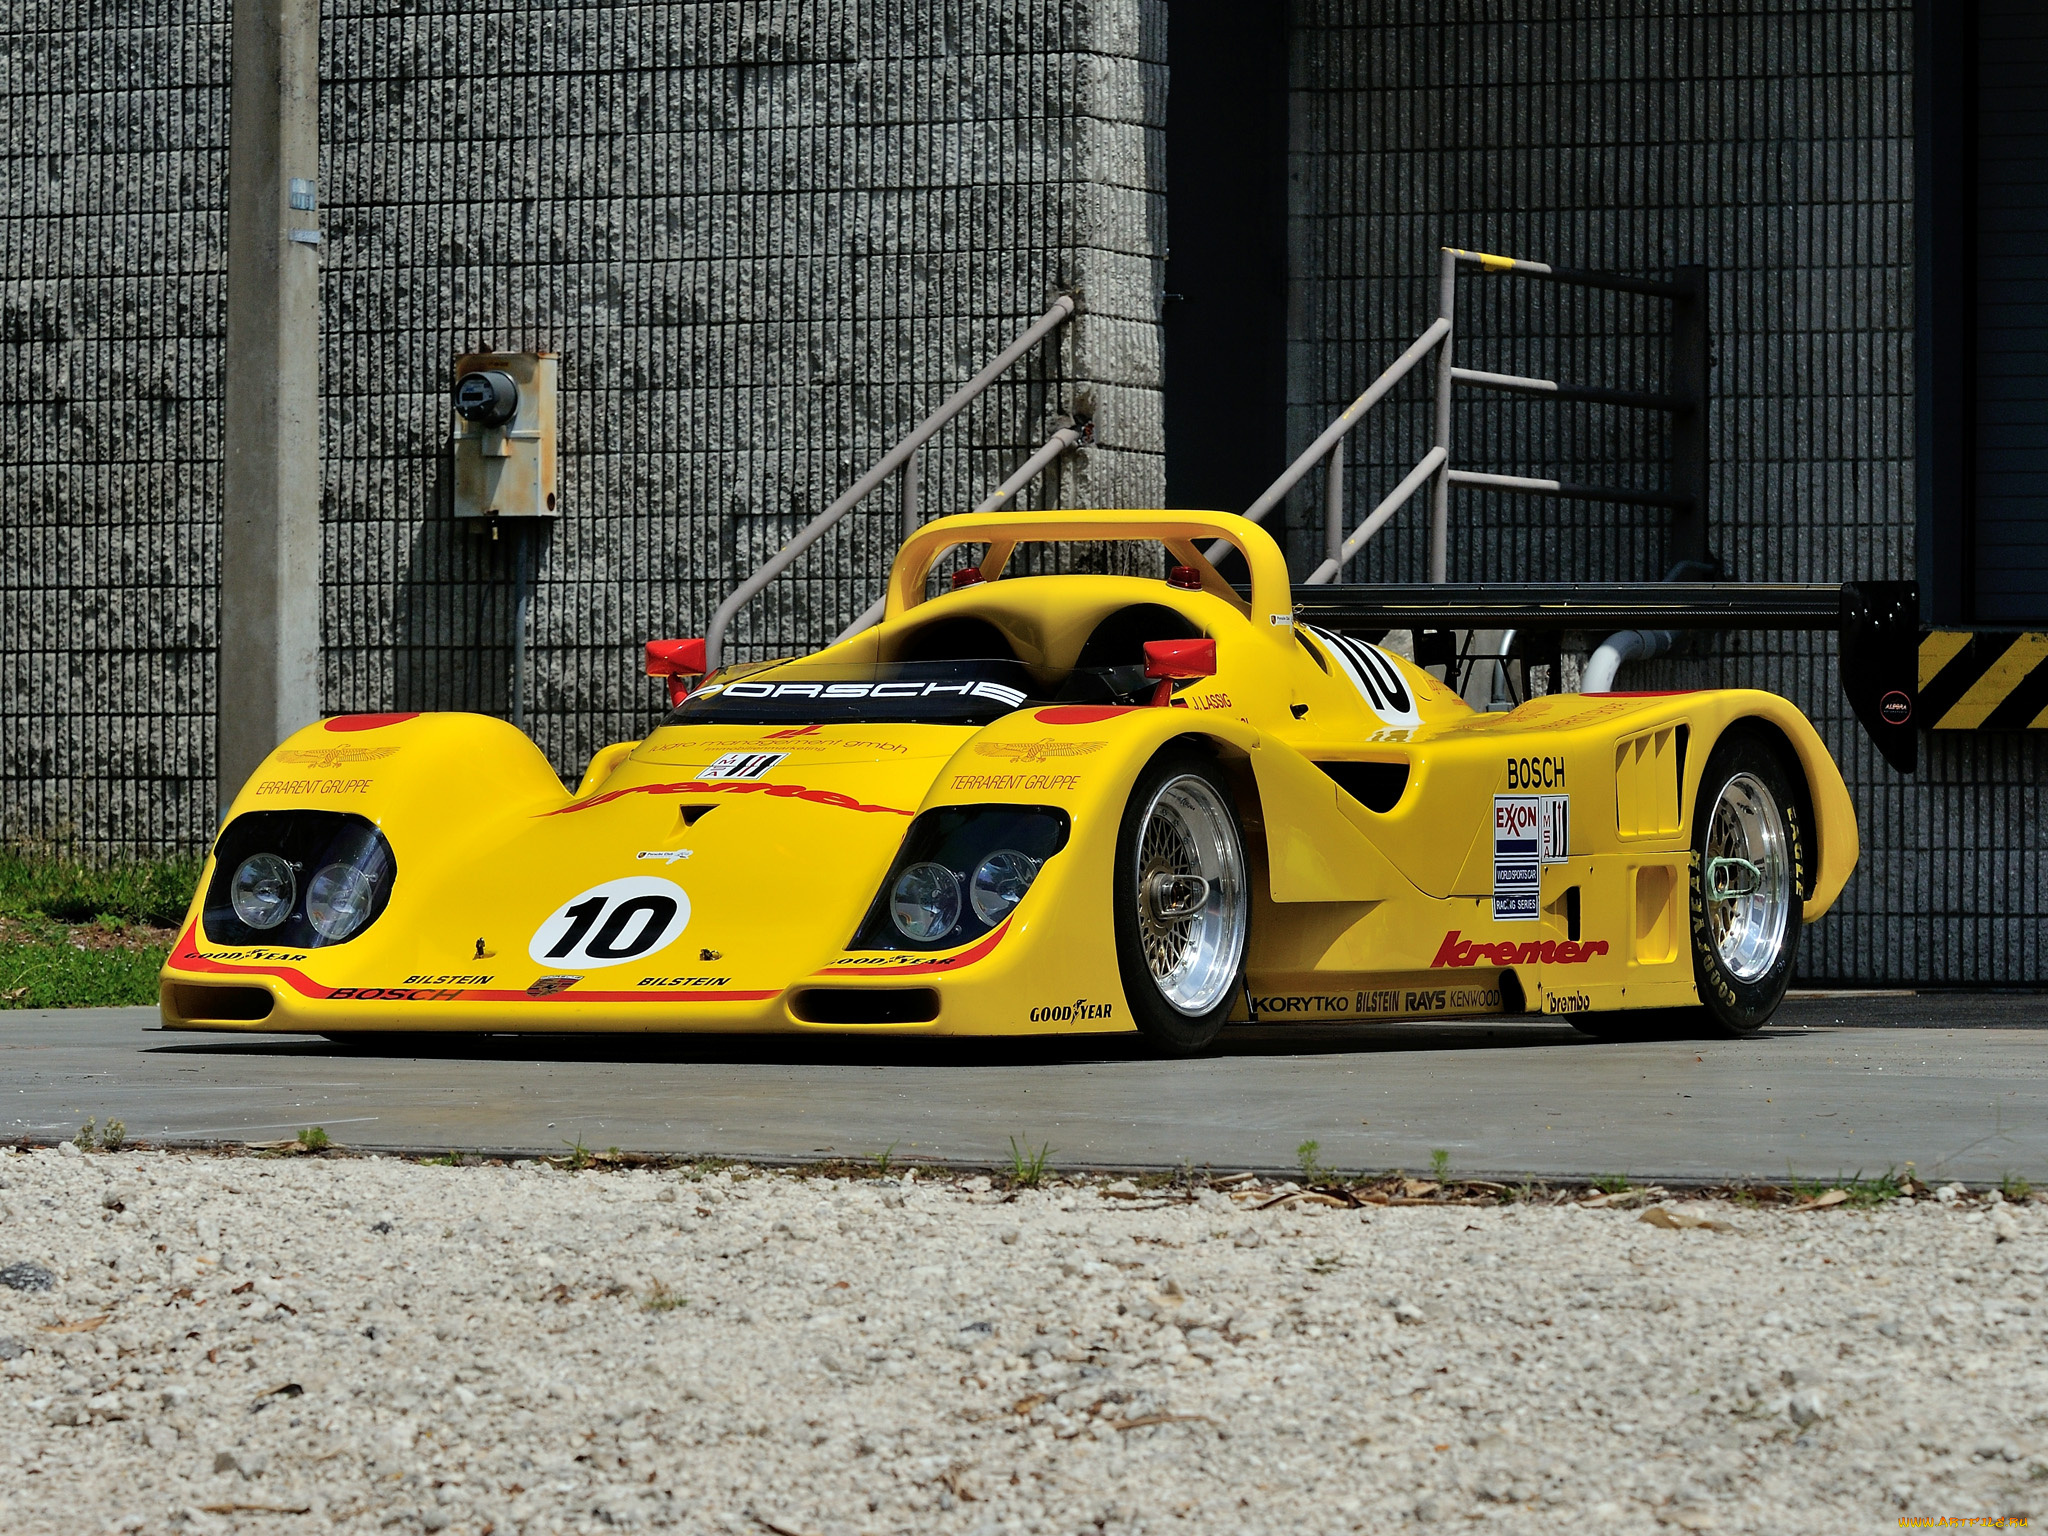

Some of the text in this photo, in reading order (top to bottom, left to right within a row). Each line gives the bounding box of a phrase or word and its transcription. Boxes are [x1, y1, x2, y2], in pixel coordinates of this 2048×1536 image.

[1309, 626, 1411, 714] 10
[675, 681, 1028, 709] PORSCHE
[699, 739, 843, 752] management
[843, 740, 908, 754] gmbh
[950, 775, 1081, 790] TERRARENT GRUPPE
[1507, 756, 1565, 789] BOSCH
[320, 779, 374, 794] GRUPPE
[1496, 803, 1537, 837] EXXON
[1542, 800, 1551, 859] IMSA
[1511, 869, 1527, 880] SPORTS
[1527, 869, 1537, 879] CAR
[1517, 899, 1536, 910] SERIES
[544, 895, 678, 958] 10
[1429, 930, 1610, 969] kremer
[402, 975, 495, 985] BILSTEIN
[636, 977, 732, 986] BILSTEIN
[325, 988, 464, 1001] BOSCH
[1253, 989, 1500, 1012] KORYTKO BILSTEIN RAYS KENWOOD
[1549, 990, 1590, 1013] brembo
